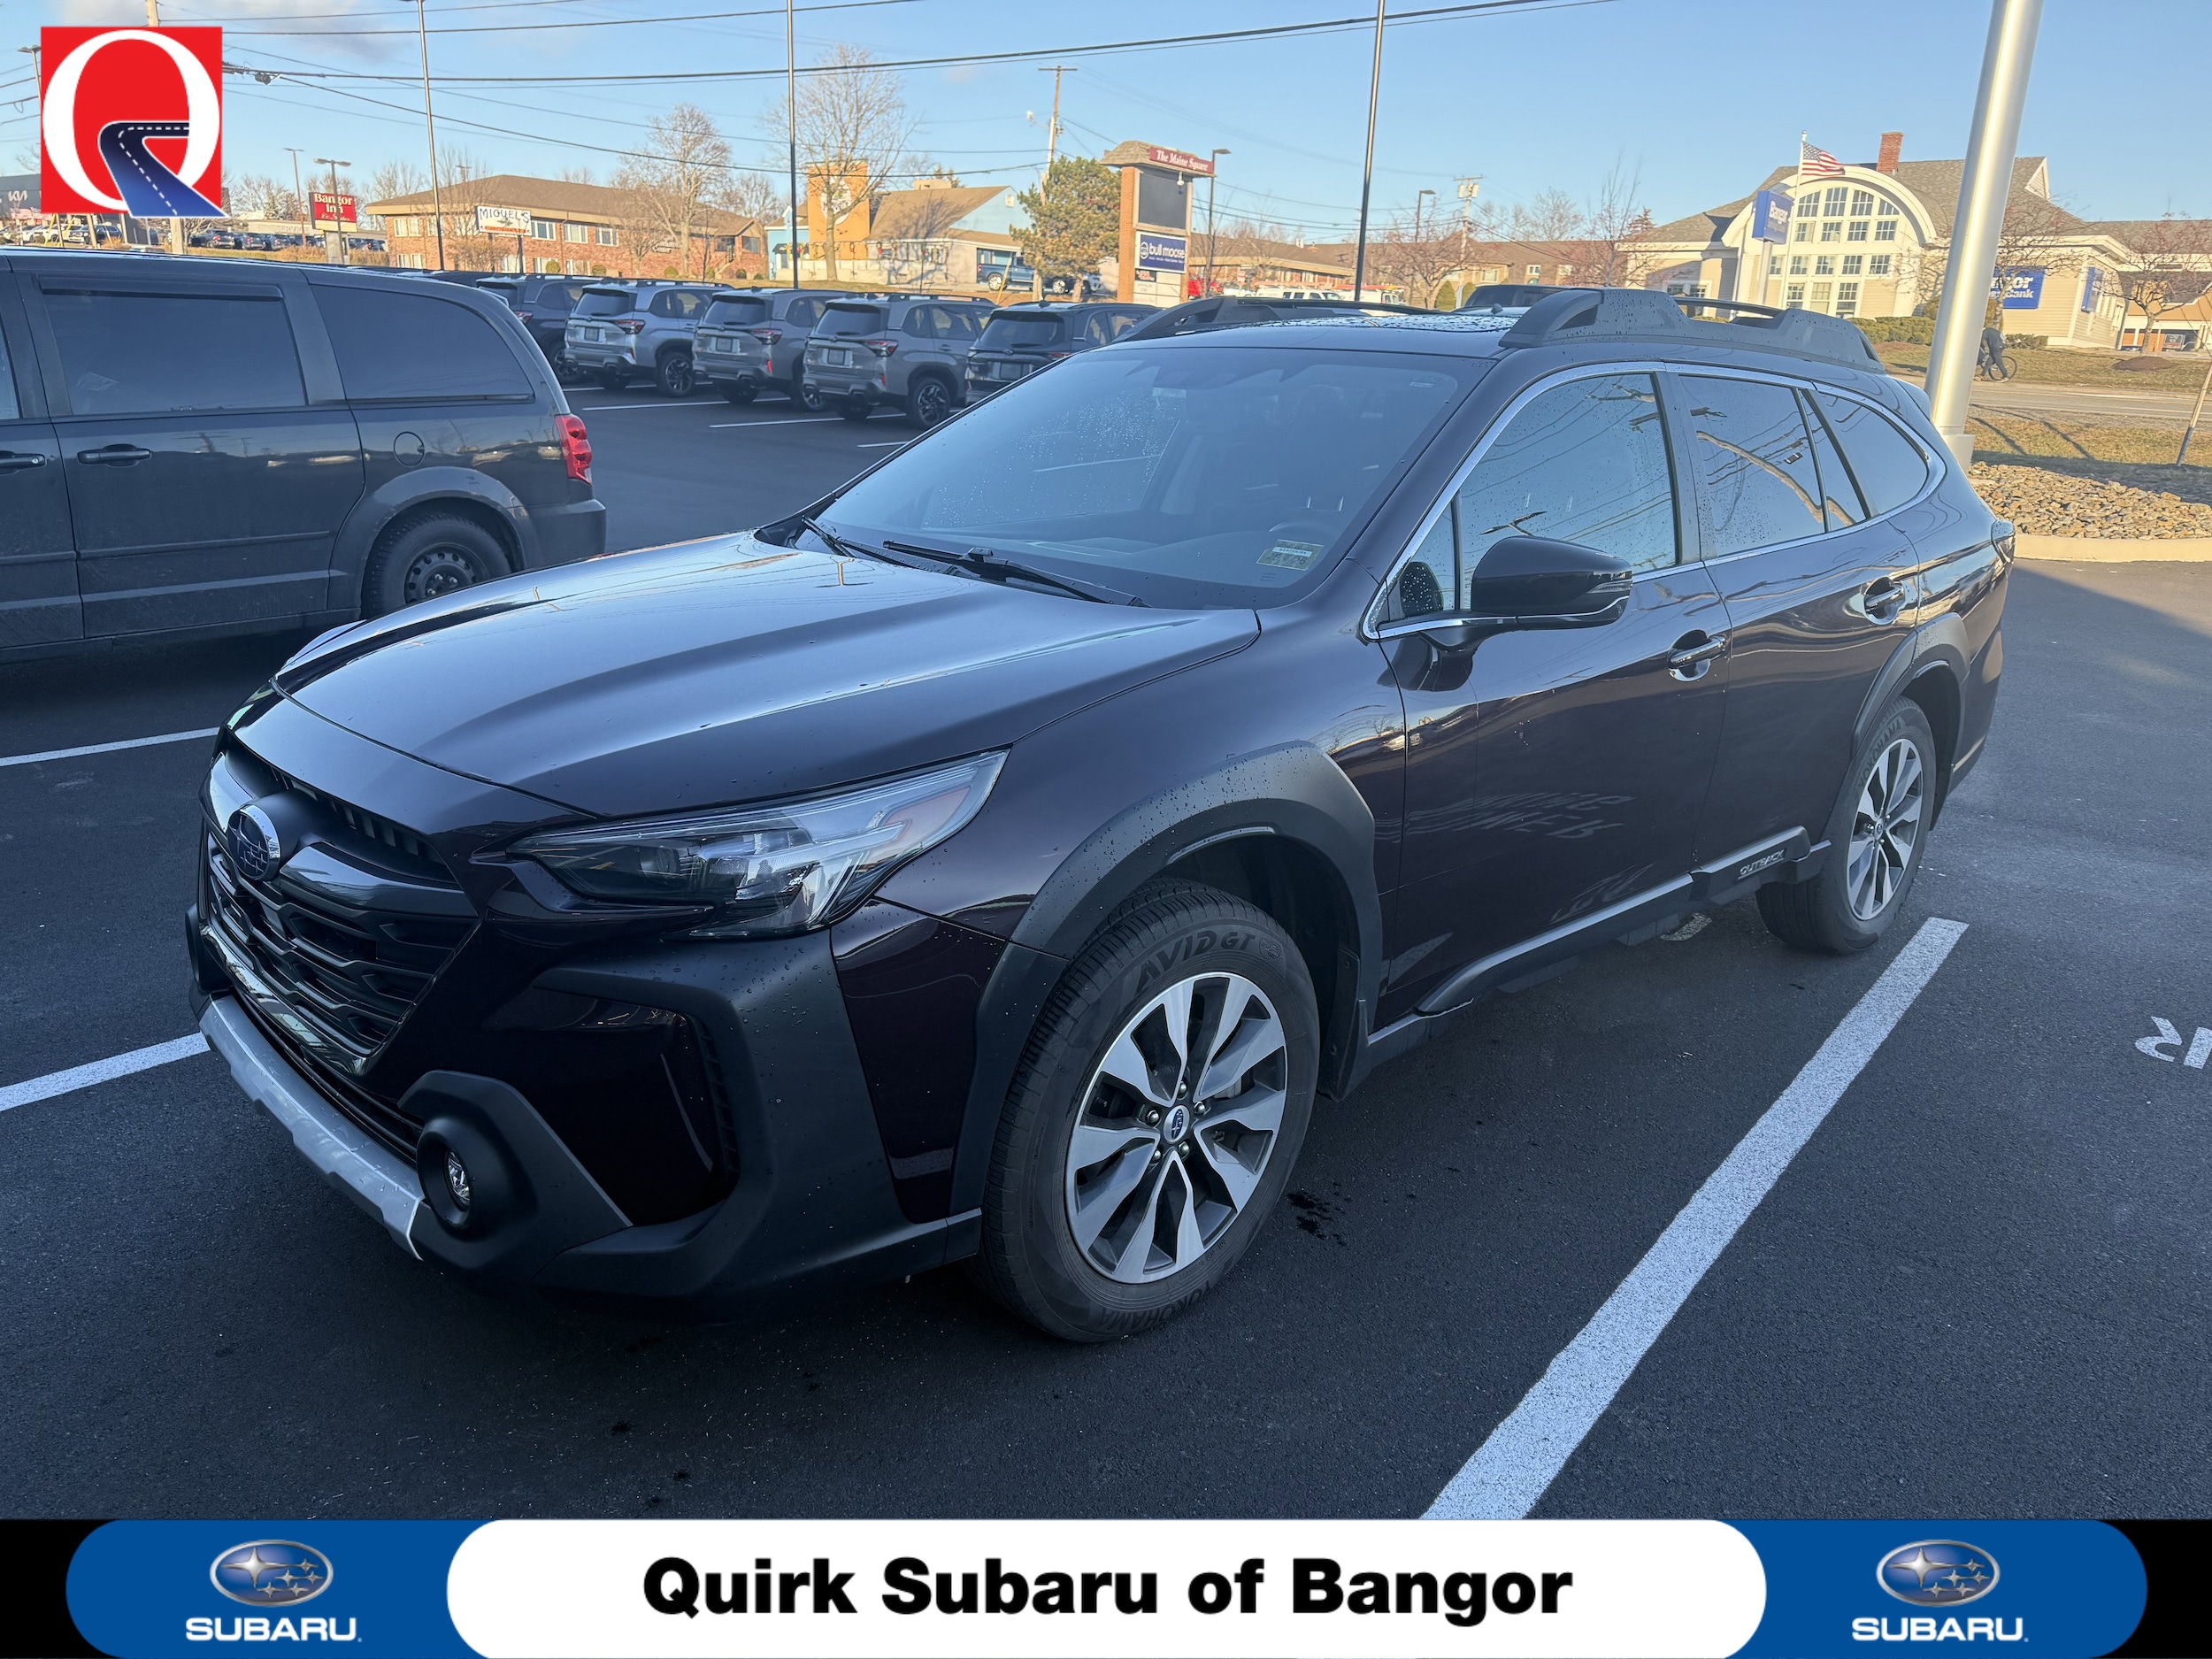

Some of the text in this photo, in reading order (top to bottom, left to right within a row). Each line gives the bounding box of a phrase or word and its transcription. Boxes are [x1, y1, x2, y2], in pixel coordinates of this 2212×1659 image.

[1156, 150, 1169, 163] The
[1188, 157, 1209, 171] Square
[313, 193, 353, 206] Bangor
[1148, 242, 1186, 259] bull moose
[1133, 929, 1217, 995] AVID
[1220, 932, 1256, 951] GT
